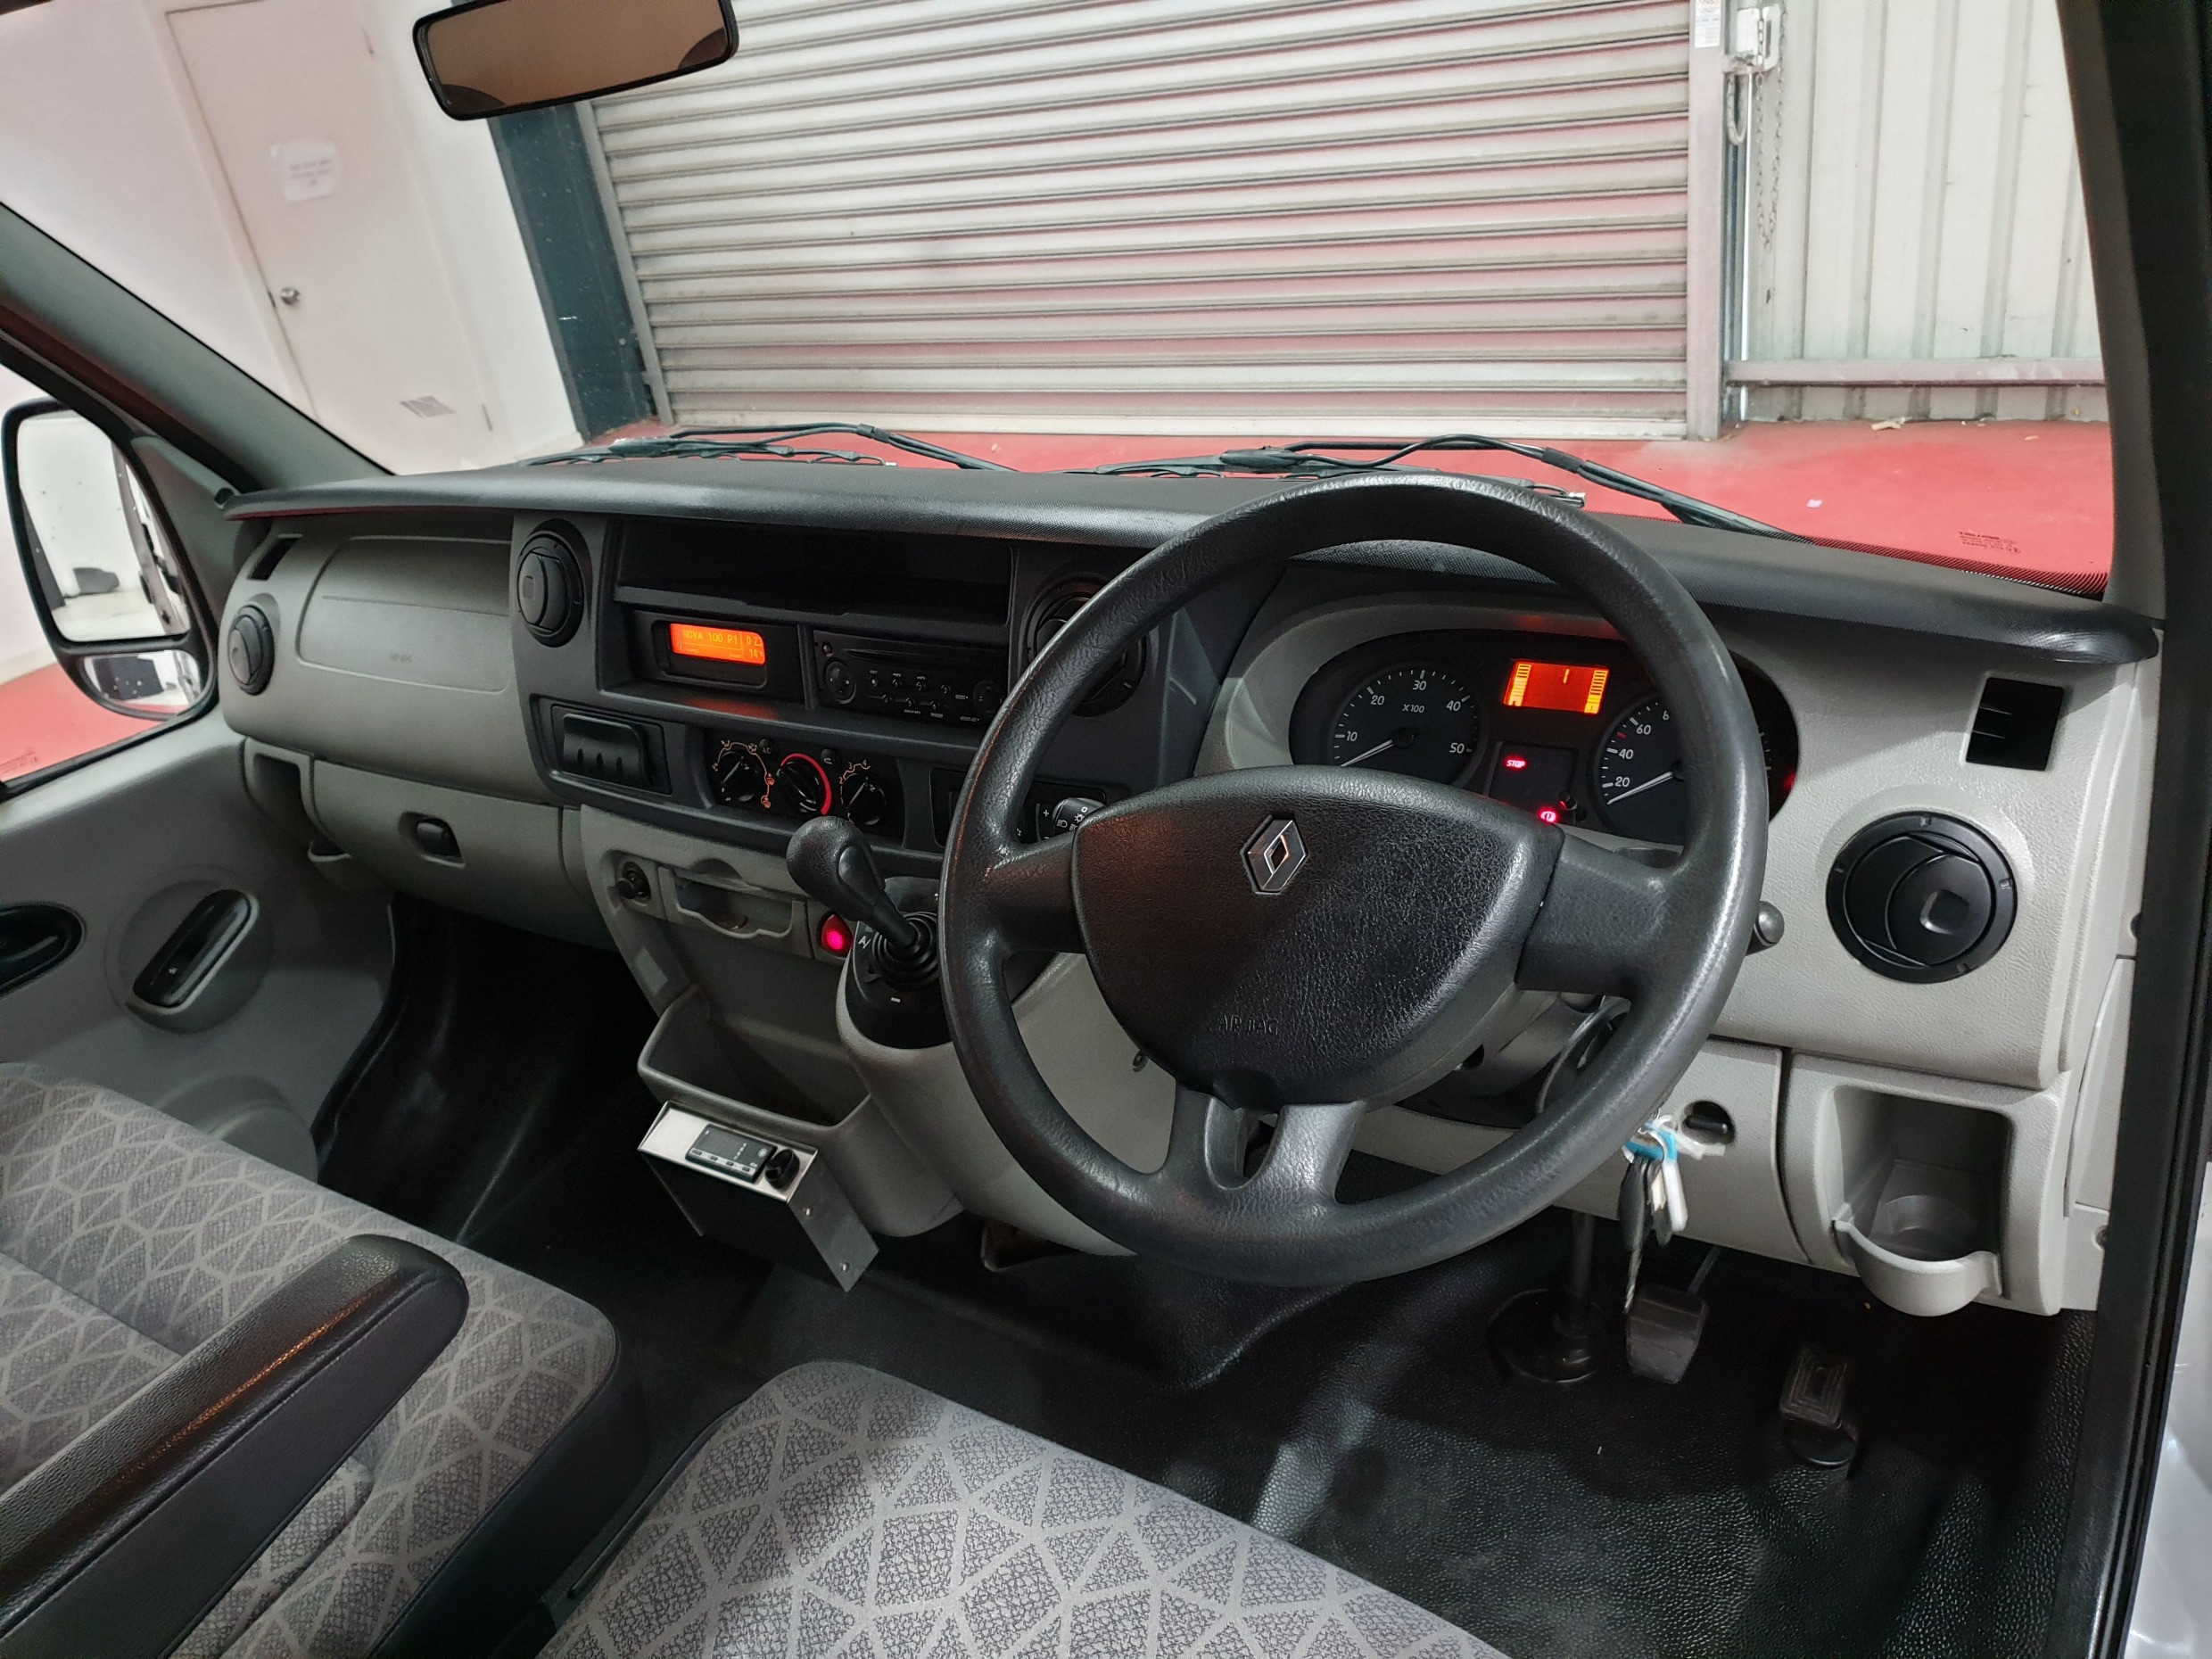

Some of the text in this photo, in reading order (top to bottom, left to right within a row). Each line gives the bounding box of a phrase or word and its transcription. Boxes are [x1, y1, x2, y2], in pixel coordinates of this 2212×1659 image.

[709, 632, 722, 643] 100
[728, 635, 738, 645] P1
[1412, 681, 1427, 691] 30
[1370, 695, 1385, 706] 20
[1402, 704, 1425, 714] X100
[1446, 701, 1461, 712] 40
[1636, 724, 1652, 735] 60
[1346, 731, 1358, 742] 10
[1449, 742, 1465, 755] 50
[1618, 748, 1634, 760] 40
[1506, 759, 1526, 769] STOP
[1614, 776, 1630, 788] 20
